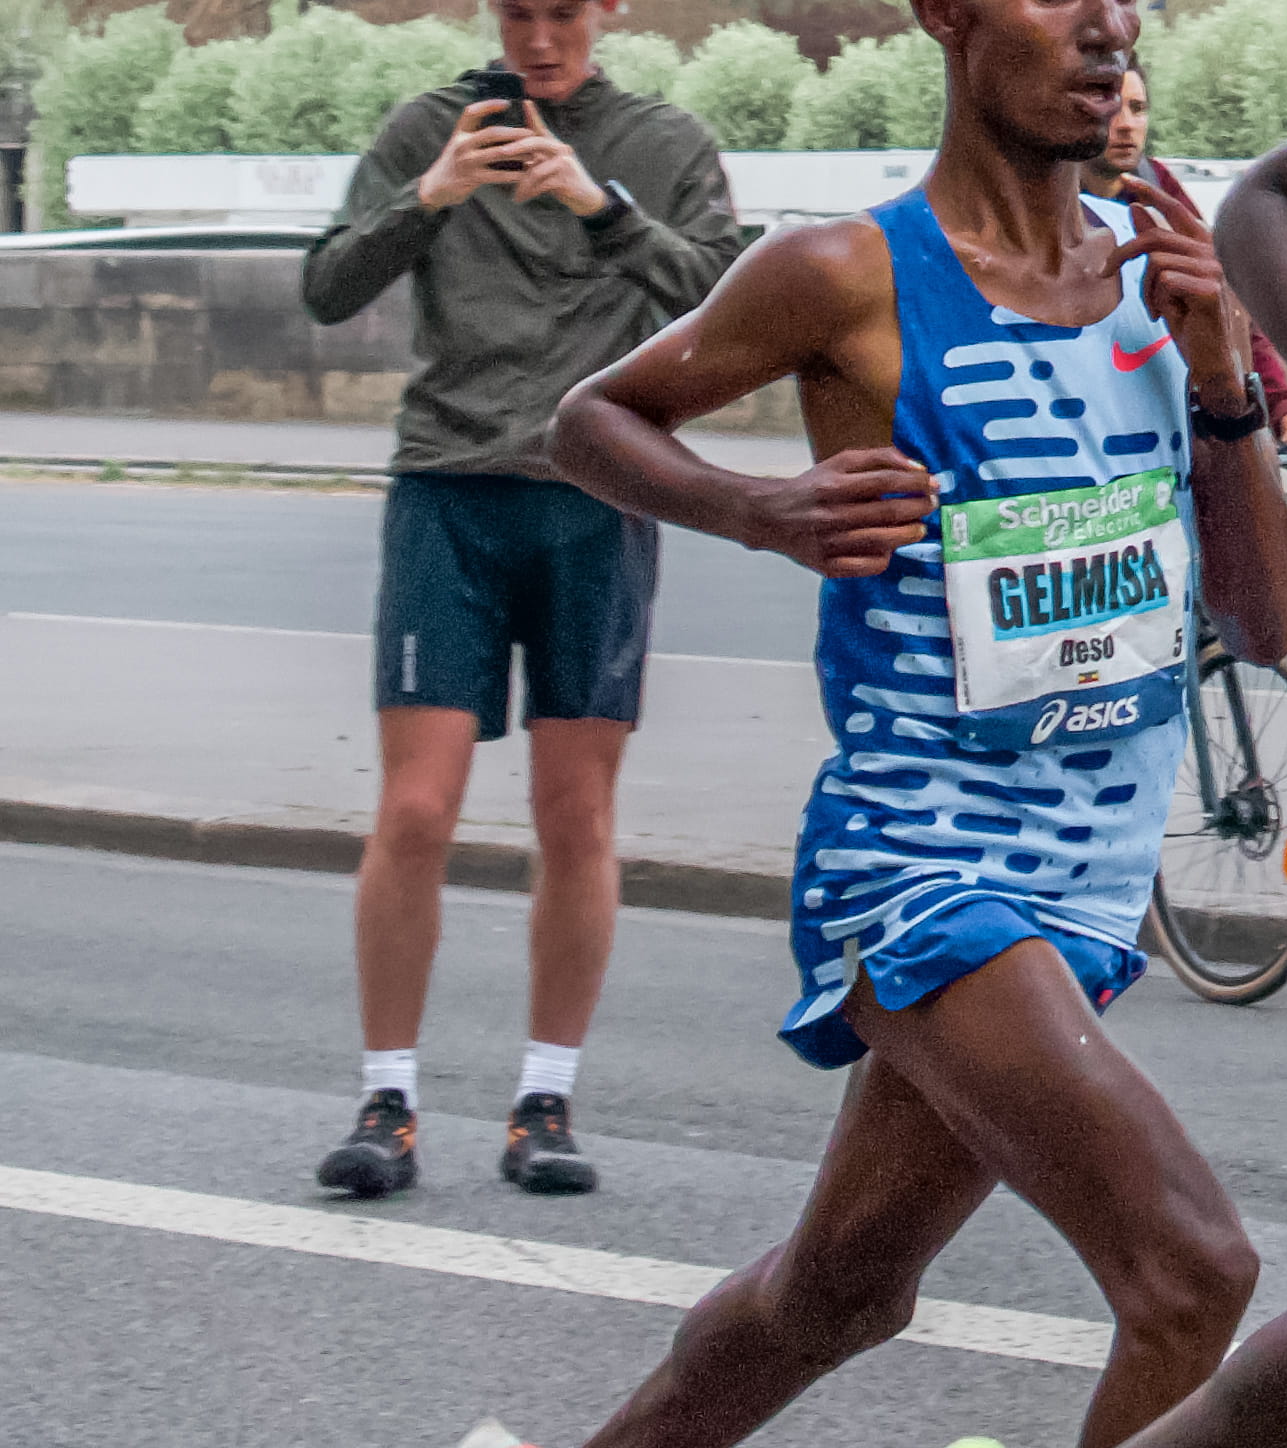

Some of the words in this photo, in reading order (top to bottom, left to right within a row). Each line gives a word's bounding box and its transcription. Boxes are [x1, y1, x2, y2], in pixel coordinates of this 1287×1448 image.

[998, 483, 1143, 530] Schneider
[1073, 511, 1142, 541] Electric
[989, 539, 1169, 630] GELMISA
[1060, 633, 1114, 666] Deso
[1173, 627, 1183, 657] 5
[1065, 694, 1140, 732] asics
